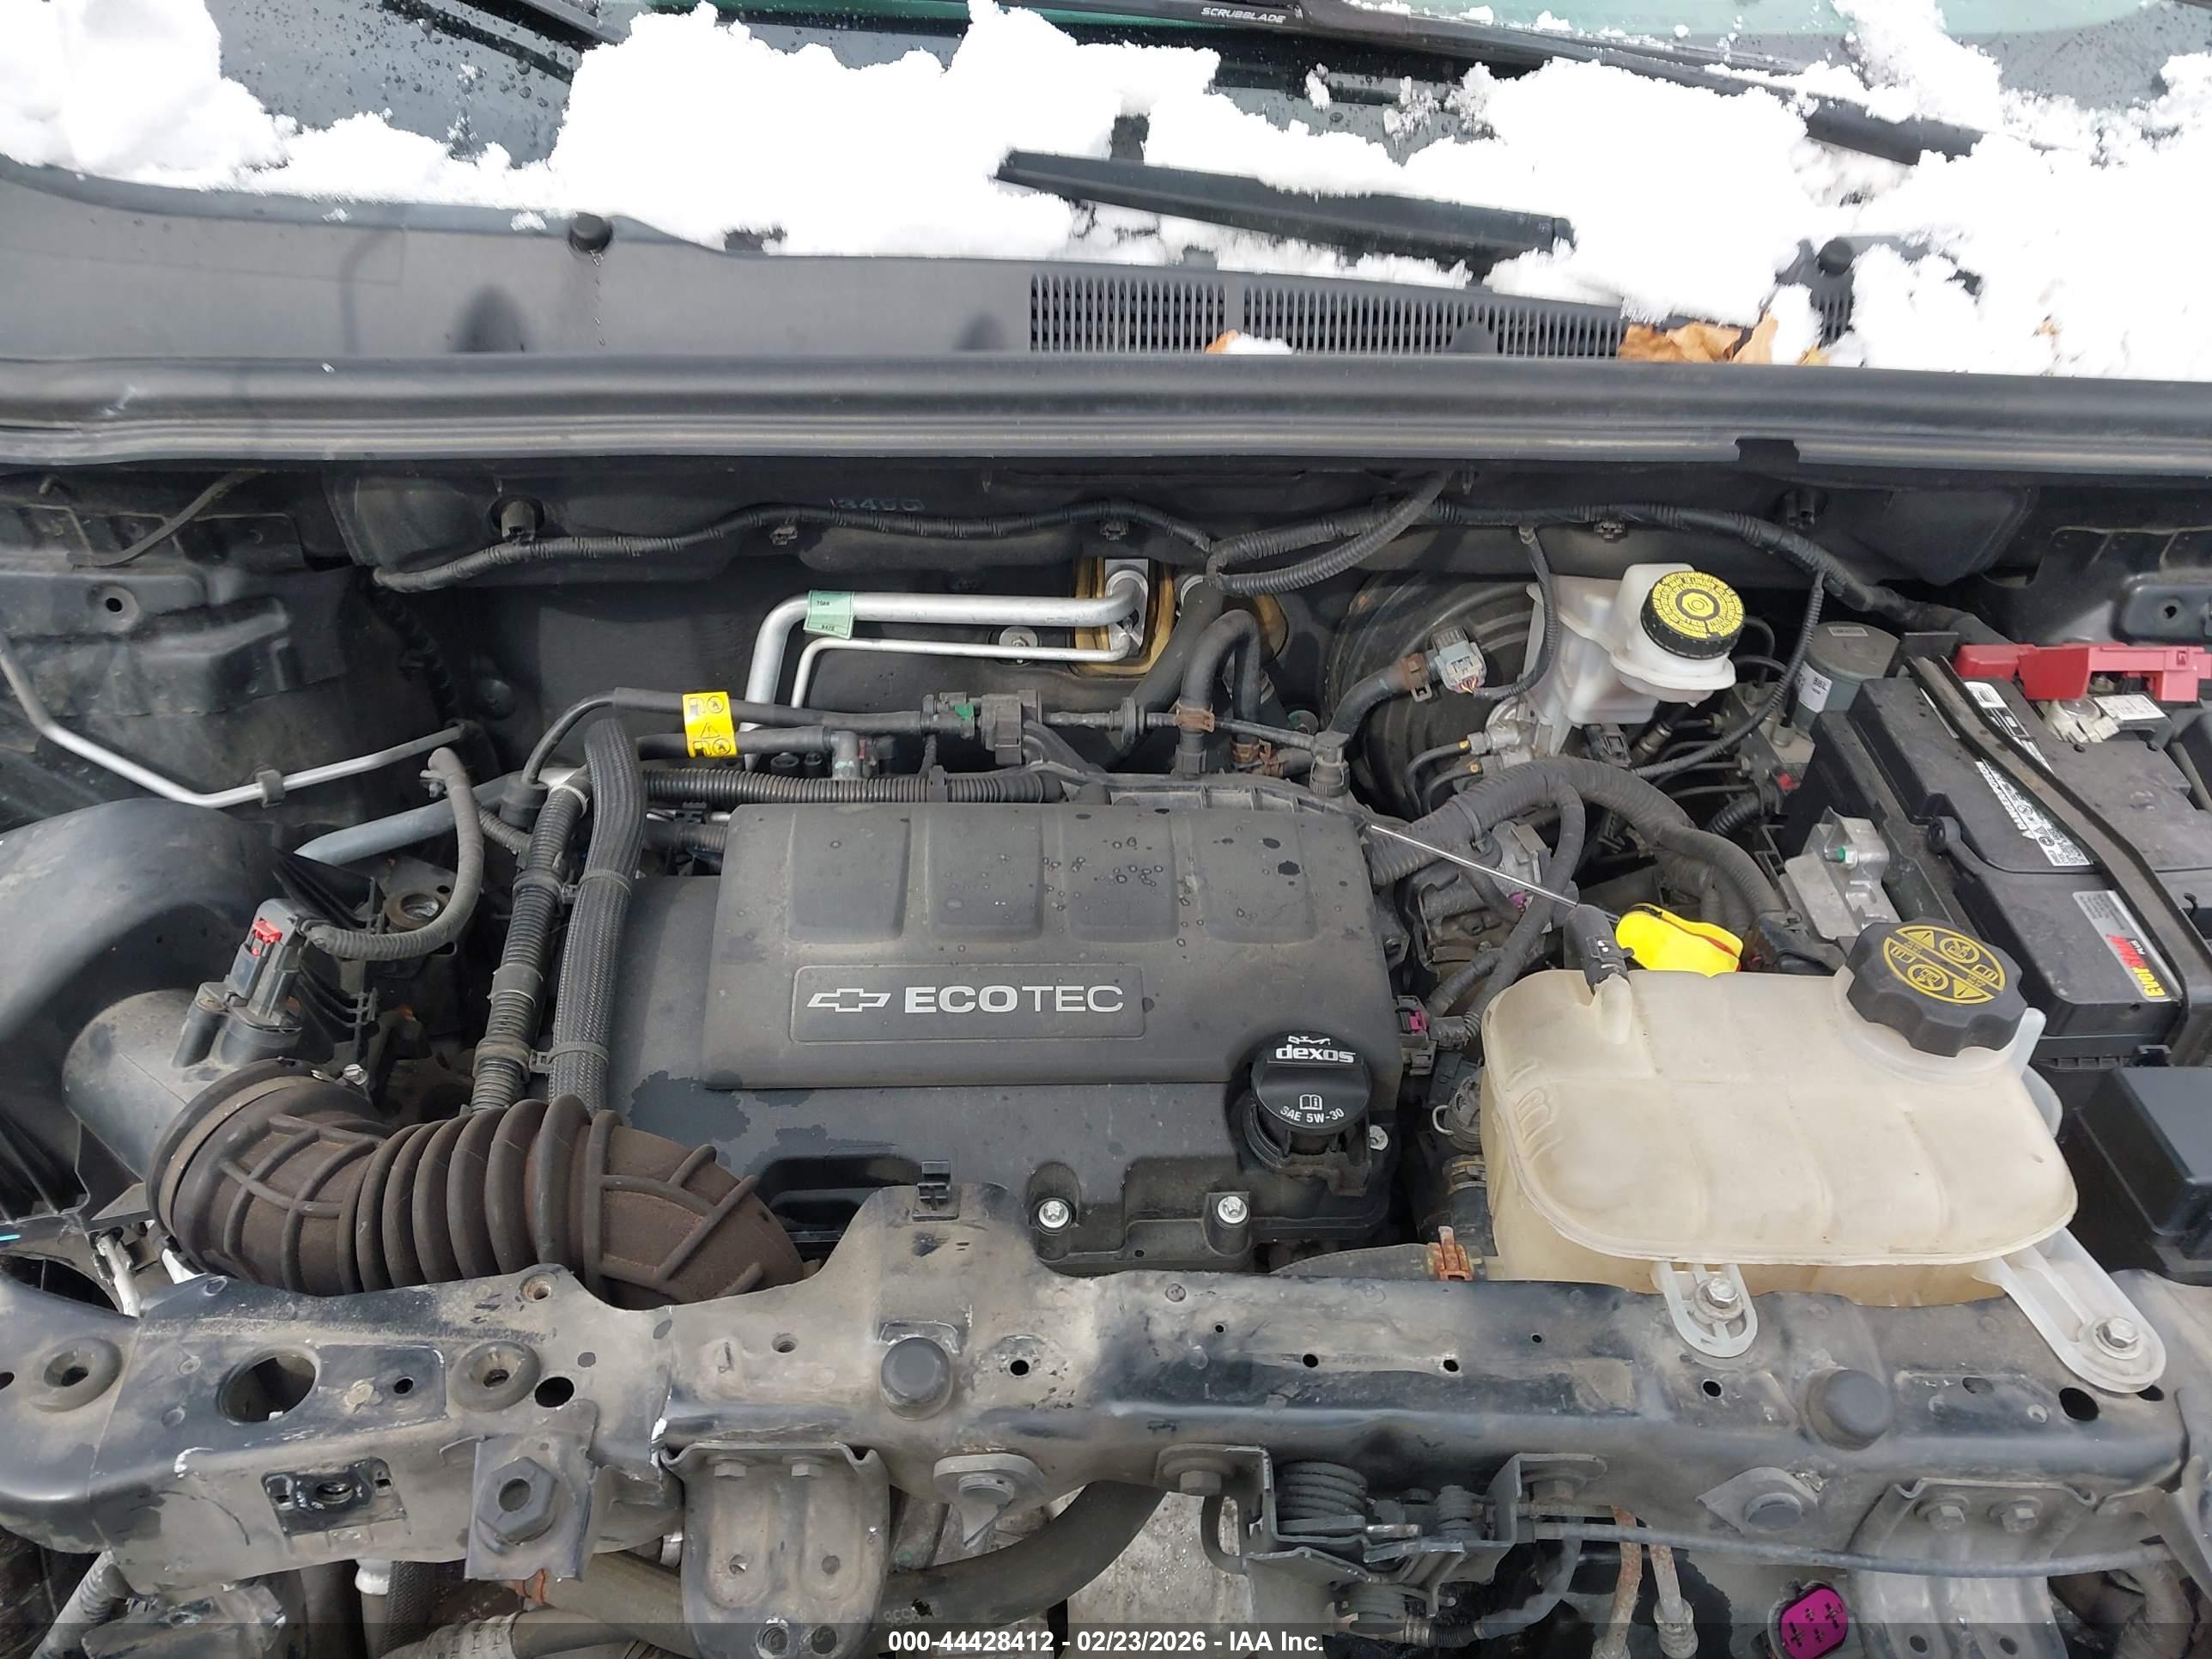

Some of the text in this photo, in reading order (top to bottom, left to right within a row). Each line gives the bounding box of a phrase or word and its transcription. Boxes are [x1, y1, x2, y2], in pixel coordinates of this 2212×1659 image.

[1200, 7, 1286, 24] SCRUBBLADE
[904, 985, 1124, 1013] ECOTEC
[1275, 1044, 1356, 1063] dexos
[1280, 1105, 1345, 1123] SAE 5W-30
